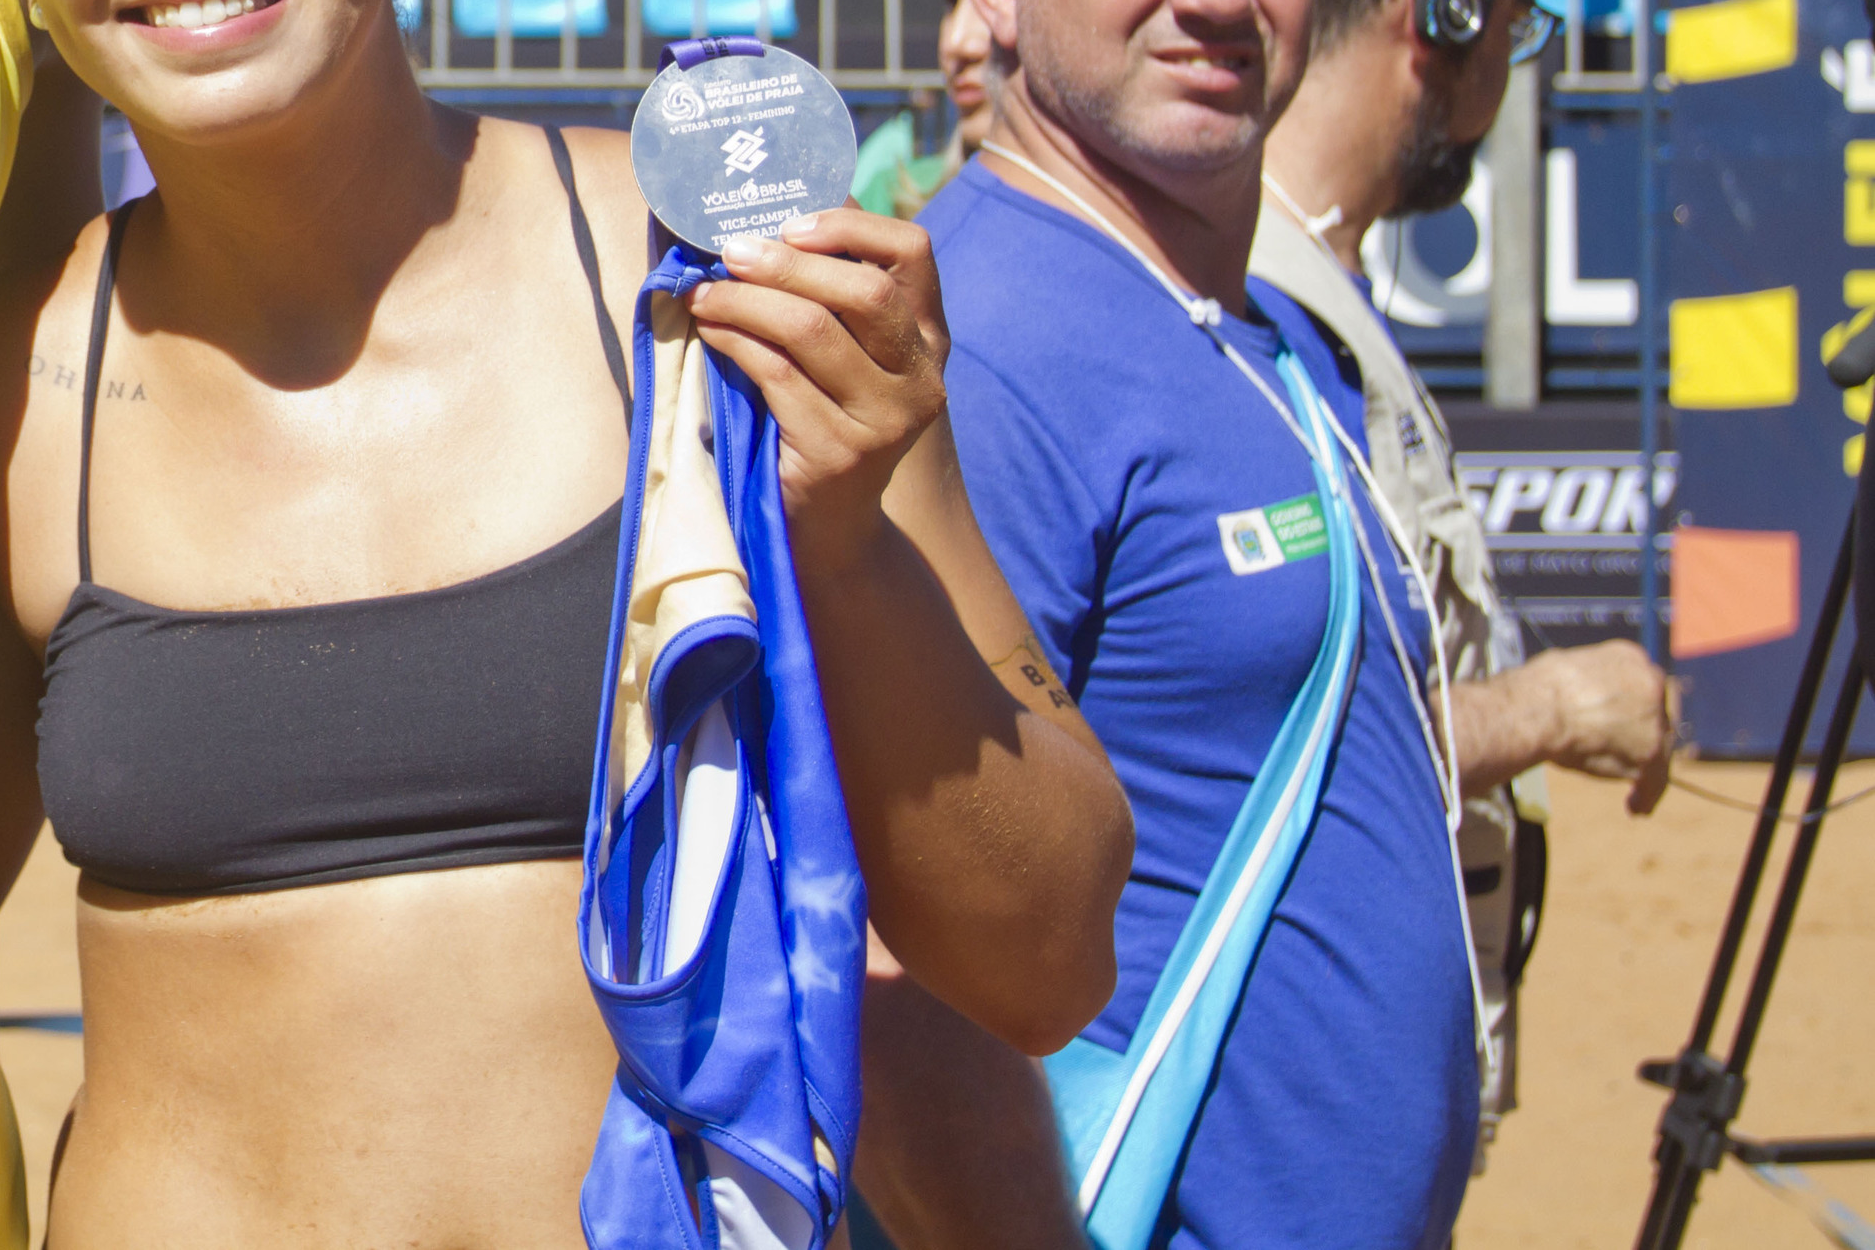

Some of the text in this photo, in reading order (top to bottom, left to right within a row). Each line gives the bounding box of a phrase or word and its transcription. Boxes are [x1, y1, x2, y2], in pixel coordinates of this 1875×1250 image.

[705, 73, 798, 98] BRASILEIRO DE
[706, 84, 804, 110] VÔLEI DE PRAIA
[680, 119, 710, 134] ETAPA
[711, 116, 730, 128] TOP
[731, 115, 742, 125] 12
[748, 105, 795, 121] FEMININO
[701, 178, 807, 206] VÔLEI BRASIL
[718, 205, 801, 231] VICE-CAMPEÃ
[25, 355, 147, 401] OHNA
